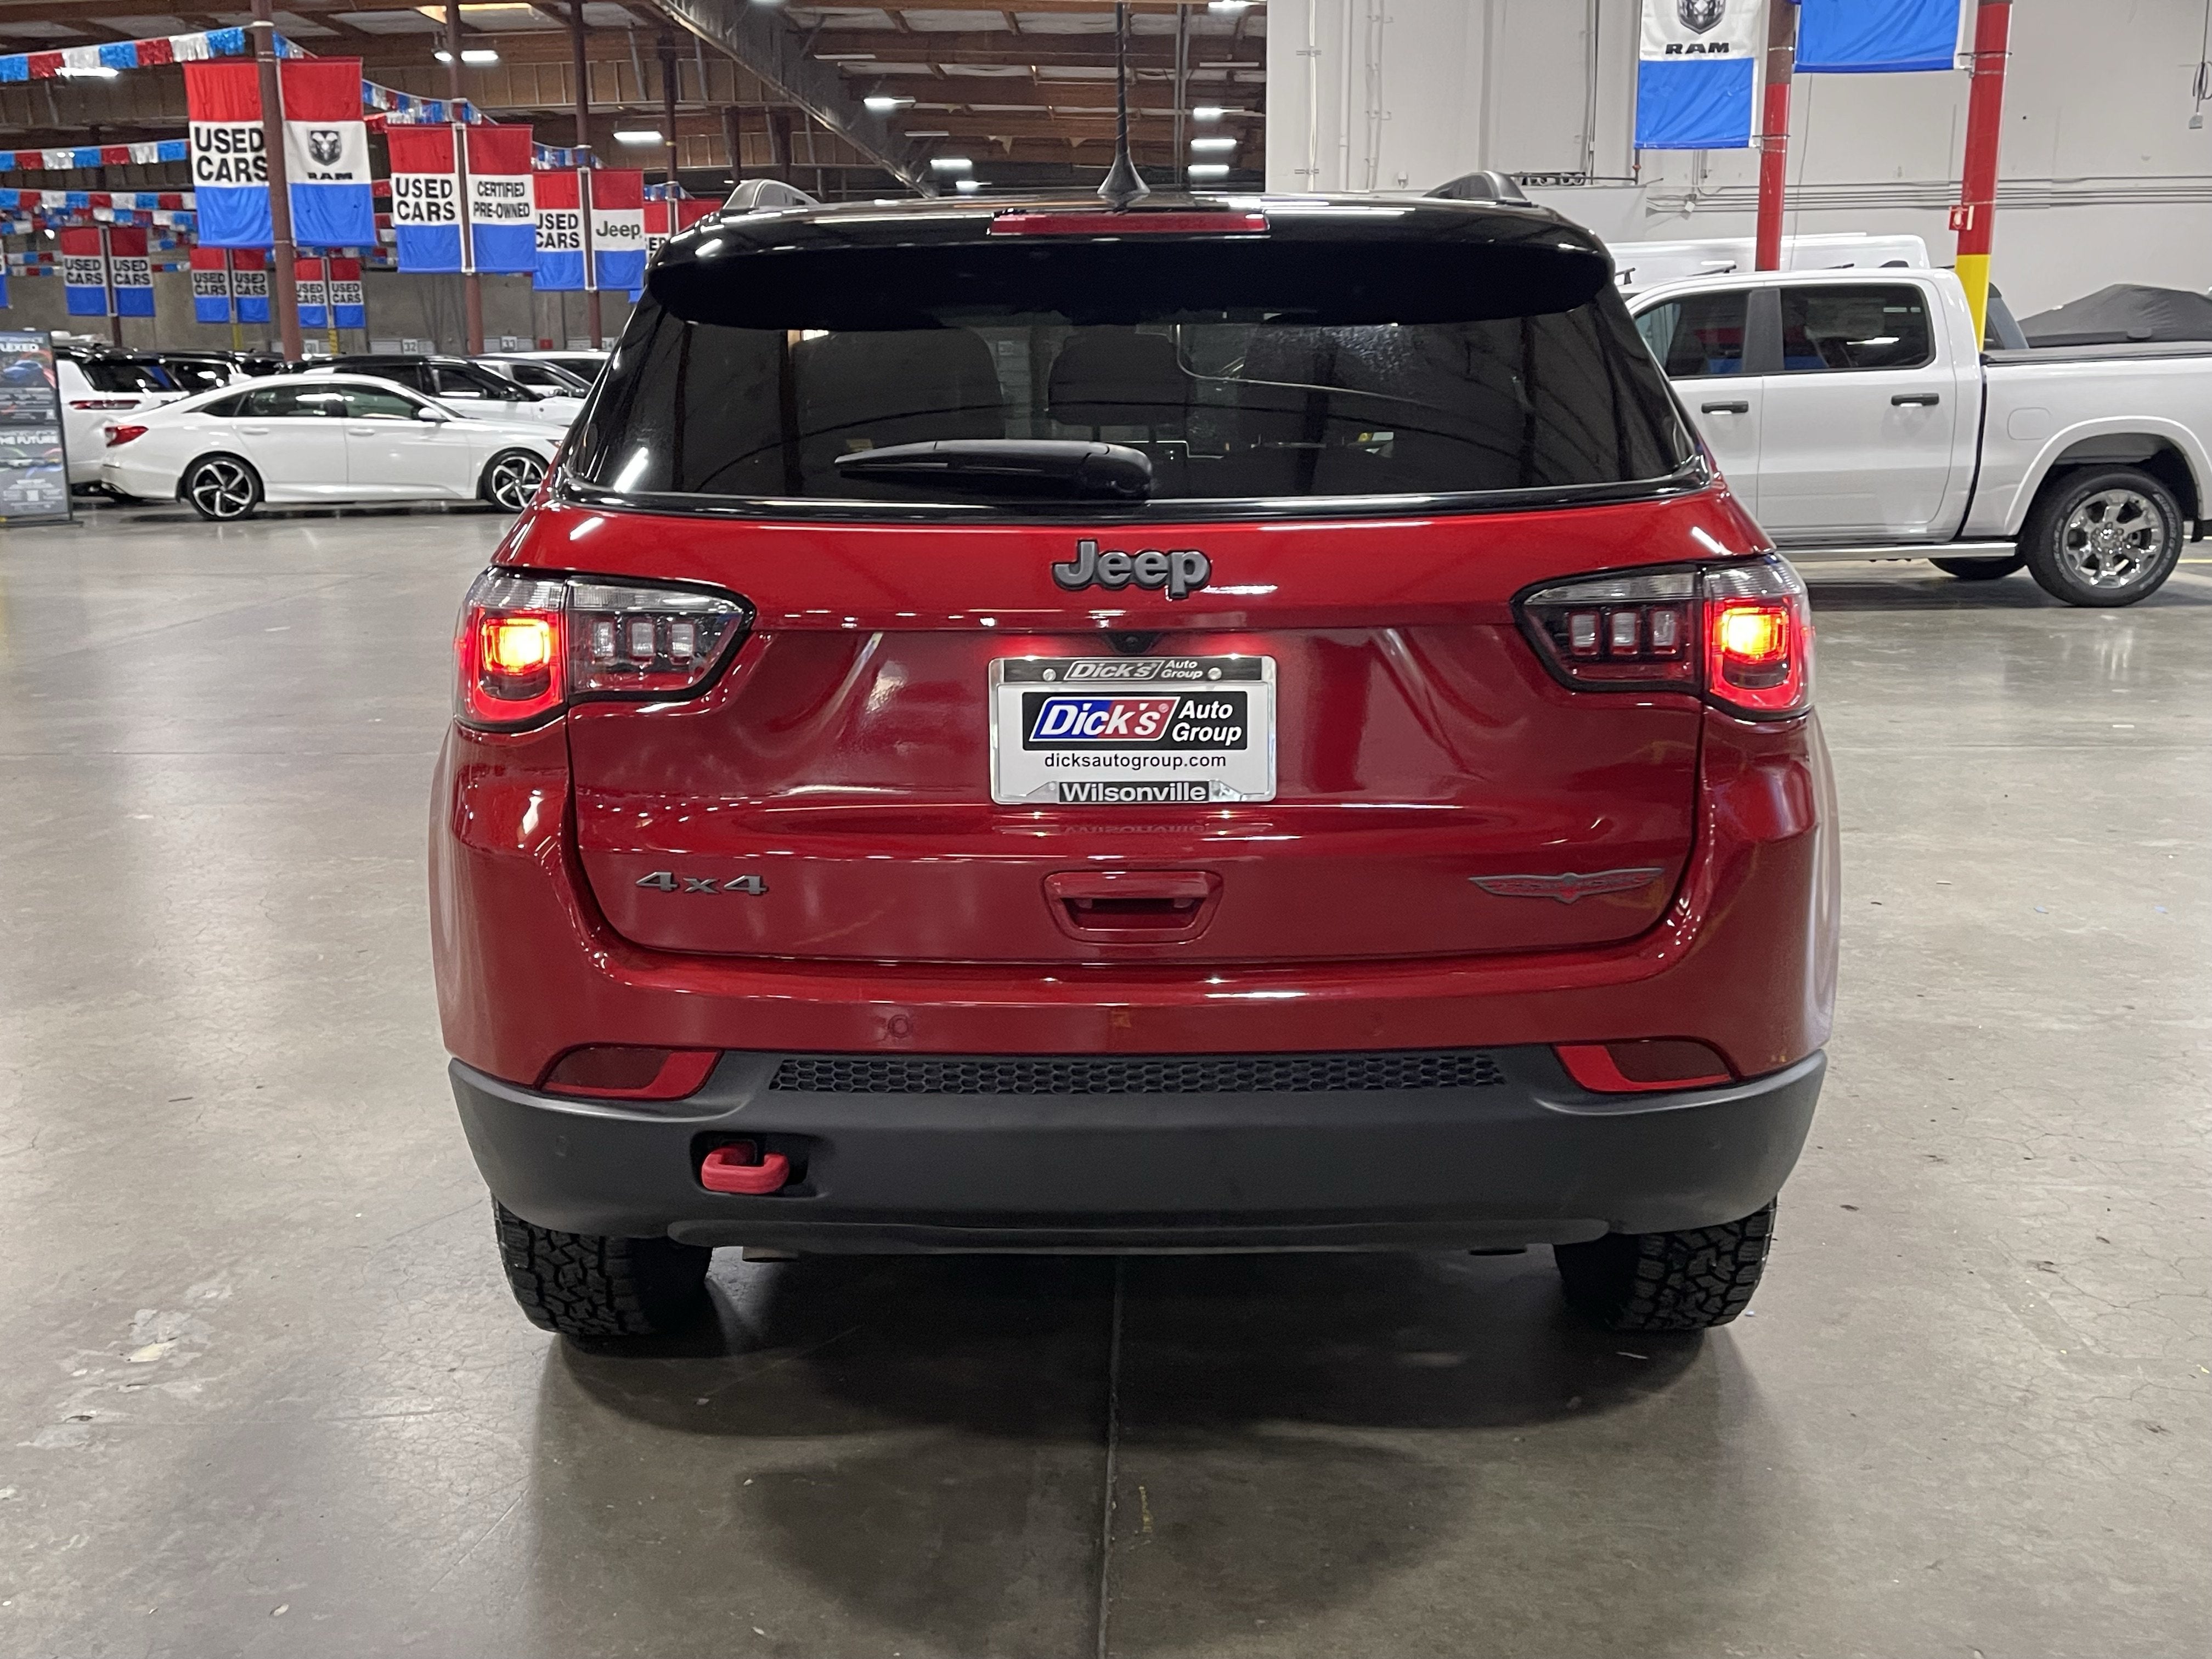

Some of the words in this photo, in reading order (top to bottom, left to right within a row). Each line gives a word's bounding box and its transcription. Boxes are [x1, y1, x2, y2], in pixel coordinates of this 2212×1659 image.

[1666, 41, 1730, 55] RAM
[194, 127, 265, 154] USED
[196, 156, 268, 182] CARS
[307, 172, 353, 180] RAM
[396, 177, 453, 198] USED
[477, 181, 525, 198] CERTIFIED
[397, 200, 455, 221] CARS
[473, 201, 530, 218] PRE-OWNED
[596, 221, 640, 239] Jeep
[65, 259, 101, 271] USED
[114, 260, 148, 272] USED
[66, 273, 103, 284] CARS
[114, 273, 150, 285] CARS
[194, 273, 225, 284] USED
[235, 273, 265, 284] USED
[195, 285, 227, 295] CARS
[235, 285, 267, 295] CARS
[332, 284, 360, 292] USED
[332, 294, 361, 303] CARS
[1052, 539, 1211, 599] Jeep
[1070, 663, 1154, 678] Dick's
[1165, 659, 1198, 669] Auto
[1160, 669, 1203, 680] Group
[1178, 700, 1233, 719] Auto
[1039, 703, 1161, 736] Dick's
[1172, 723, 1242, 746] Group
[1044, 753, 1227, 770] dicksautogroup.com
[1061, 782, 1207, 802] Wilsonville
